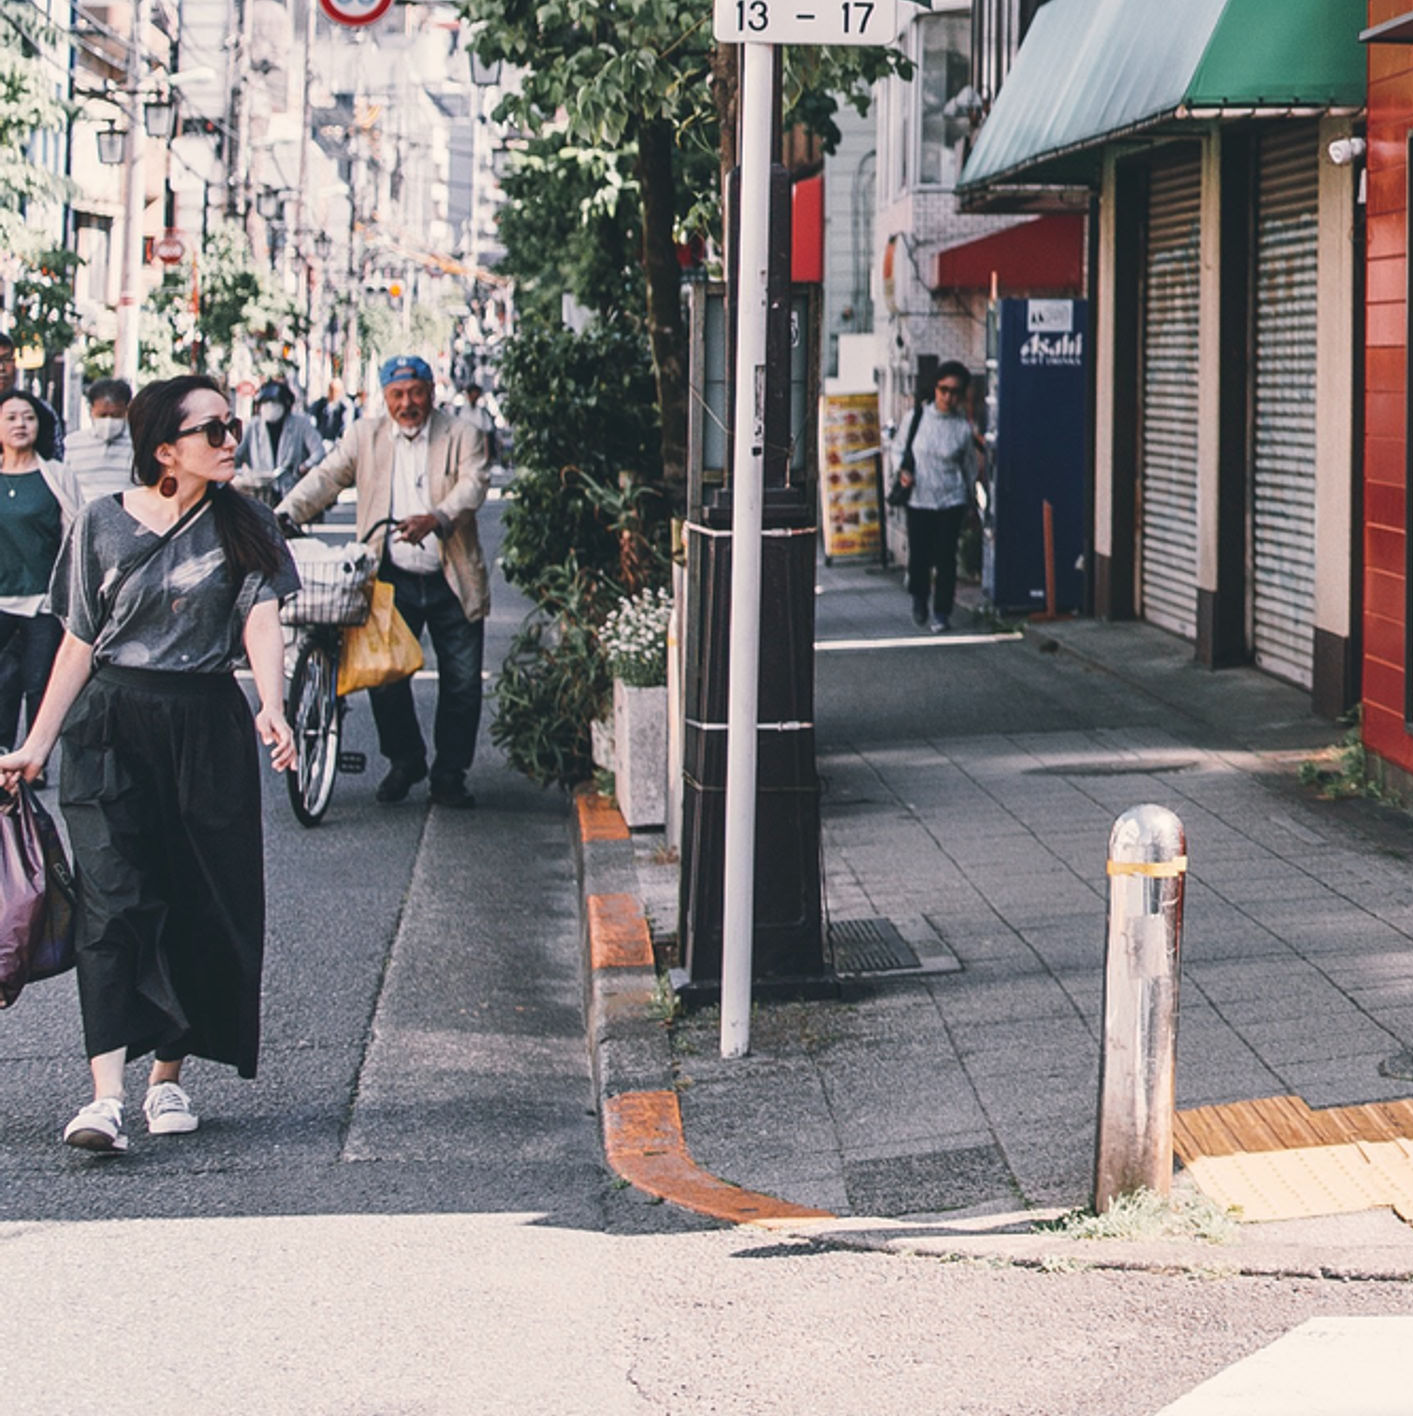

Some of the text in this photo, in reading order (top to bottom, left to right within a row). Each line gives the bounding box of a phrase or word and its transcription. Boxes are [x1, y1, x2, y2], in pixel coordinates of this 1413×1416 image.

[736, 0, 769, 31] 13
[841, 2, 874, 33] 17
[1020, 332, 1082, 356] Asahi
